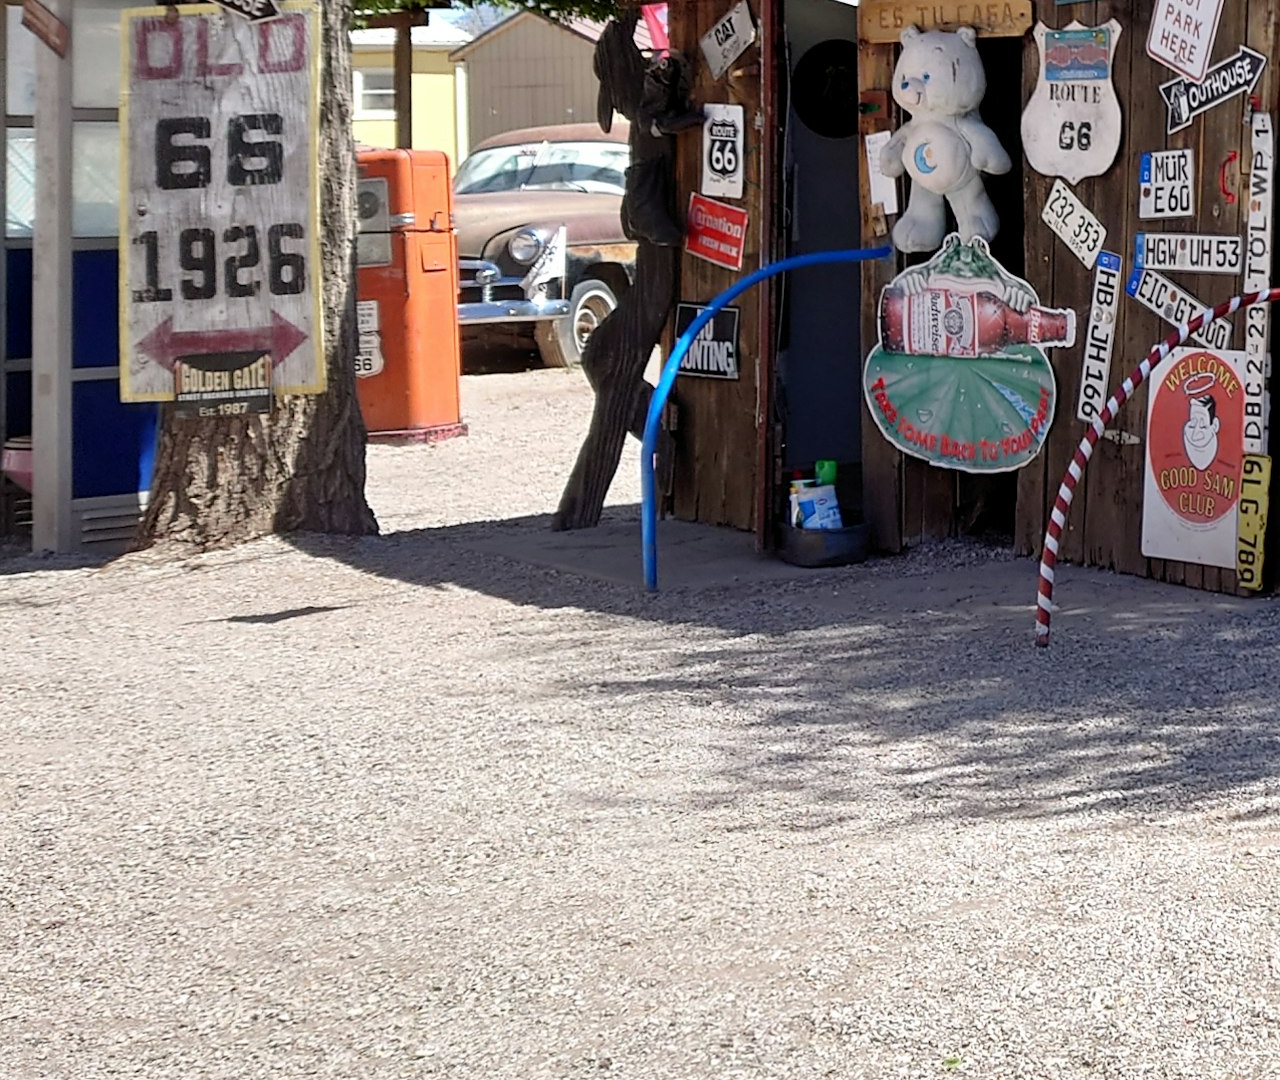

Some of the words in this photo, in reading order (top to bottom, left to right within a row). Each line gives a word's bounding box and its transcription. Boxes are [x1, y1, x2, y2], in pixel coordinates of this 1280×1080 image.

[713, 15, 736, 47] CAT
[1164, 4, 1203, 41] PARK
[135, 13, 304, 79] OLD
[1159, 28, 1197, 64] HERE
[1050, 82, 1101, 105] ROUTE
[1188, 57, 1254, 108] OUTHOUSE
[712, 125, 736, 138] ROUTE
[156, 113, 284, 190] 66
[712, 140, 736, 171] 66
[1154, 187, 1165, 213] E
[1168, 185, 1190, 212] 60
[692, 204, 742, 238] Carnation
[1049, 188, 1075, 227] 232
[1073, 215, 1100, 252] 353
[131, 222, 306, 303] 1926
[1145, 237, 1177, 267] HGW
[1189, 238, 1212, 266] UH
[1215, 238, 1240, 268] 53
[1096, 270, 1116, 307] HB
[930, 291, 942, 354] Budweiser
[1031, 310, 1042, 344] Bud
[677, 337, 735, 373] UNTING
[1089, 324, 1109, 365] JH
[181, 362, 230, 393] GOLDEN
[233, 356, 265, 389] GATE
[1081, 367, 1104, 418] 166
[1165, 355, 1239, 398] WELCOME
[218, 402, 248, 416] 1987
[977, 438, 999, 462] TO
[1160, 466, 1197, 491] GOOD
[1203, 470, 1235, 500] SAM
[1178, 492, 1215, 518] CLUB
